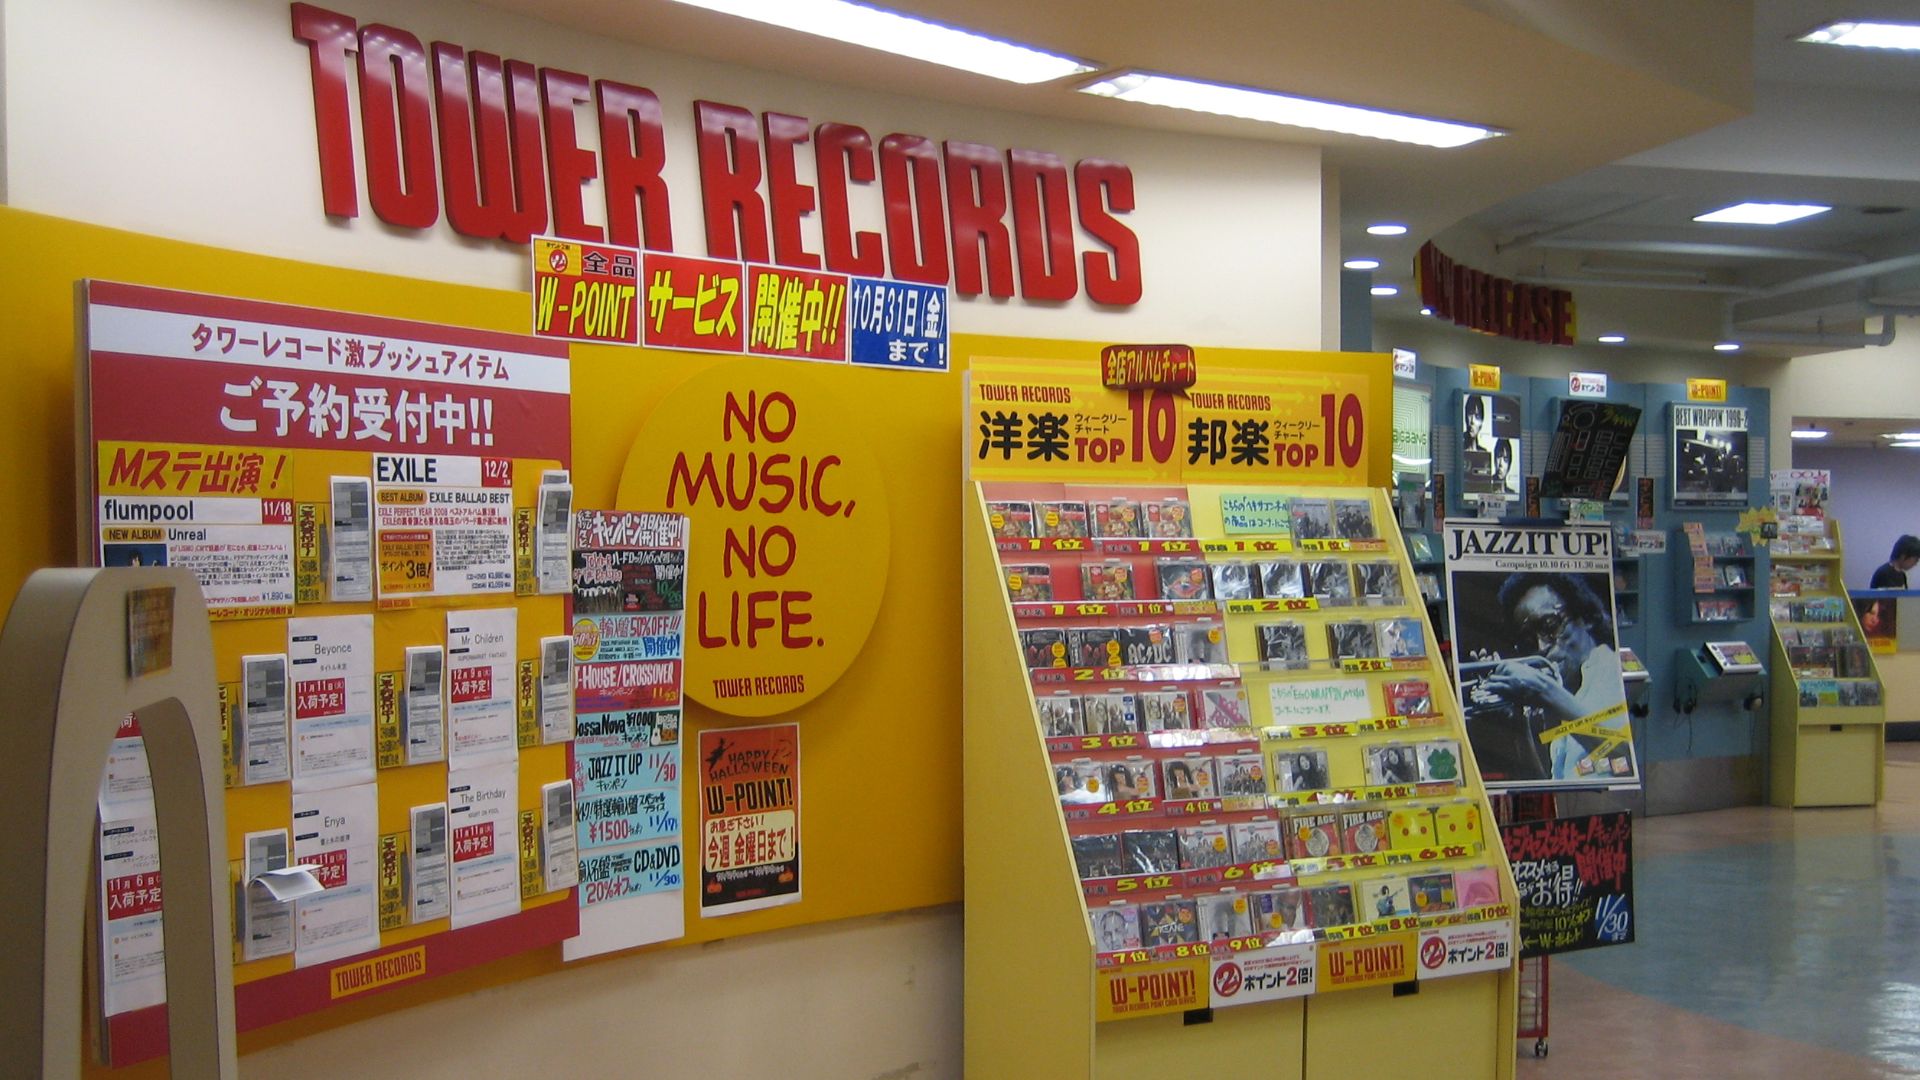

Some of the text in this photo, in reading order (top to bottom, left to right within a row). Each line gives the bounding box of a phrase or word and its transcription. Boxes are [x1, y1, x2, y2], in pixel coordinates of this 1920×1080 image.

[290, 2, 1142, 305] TOWER RECORDS
[583, 252, 635, 278] 全品
[536, 276, 635, 339] W-POINT
[648, 271, 739, 337] サービス
[750, 273, 846, 352] 開催中!!
[191, 322, 510, 381] タワーレコード激プッシュアイテム
[979, 384, 1071, 404] TOWER RECORDS
[1191, 392, 1271, 412] TOWER RECORDS
[219, 375, 494, 447] ご予約受付中!!
[723, 390, 797, 444] NO
[1074, 413, 1127, 424] ウィークリー
[1675, 407, 1691, 426] BEST
[978, 410, 1070, 462] 洋楽
[1074, 388, 1176, 465] TOP 10
[1074, 424, 1110, 435] チャート
[1273, 419, 1320, 430] ウィークリー
[1273, 430, 1305, 441] チャート
[1274, 392, 1364, 469] TOP 10
[1187, 417, 1270, 467] 邦楽
[377, 457, 437, 483] EXILE
[484, 460, 509, 478] 12/2
[381, 492, 424, 501] BEST ALBUM
[665, 451, 856, 518] MUSIC,
[104, 499, 194, 522] flumpool
[263, 501, 292, 517] 11/18
[429, 492, 510, 504] EXILE BALLAD BEST
[109, 530, 161, 540] NEW ALBUM
[168, 528, 207, 541] Unreal
[593, 511, 684, 547] キャンペーン開催中!
[723, 525, 797, 578] NO
[1449, 529, 1609, 561] JAZZ IT UP!
[1495, 559, 1538, 570] Campaign
[1539, 559, 1559, 569] 10.10
[698, 590, 825, 649] LIFE.
[475, 633, 504, 645] Children
[452, 680, 490, 695] 入荷予定!
[713, 674, 805, 699] TOWER RECORDS
[297, 694, 343, 710] 入荷予定!
[588, 755, 612, 781] JAZZ
[614, 754, 627, 777] IT
[628, 753, 643, 775] UP
[728, 749, 771, 765] HAPPY
[709, 761, 789, 782] HALLOWEEN
[460, 788, 506, 804] The Birthday
[706, 777, 794, 815] W-POINT!
[324, 815, 346, 828] Enya
[589, 819, 629, 844] ¥1500
[454, 838, 492, 854] 入荷予定!
[634, 845, 680, 874] CD&DVD
[1595, 893, 1629, 939] 11/30
[1329, 943, 1405, 977] W-POINT!
[1447, 941, 1509, 965] ポイント2倍!
[336, 951, 422, 993] TOWER RECORDS
[1244, 966, 1313, 992] ポイント2倍!
[1110, 969, 1196, 1006] W-POINT!
